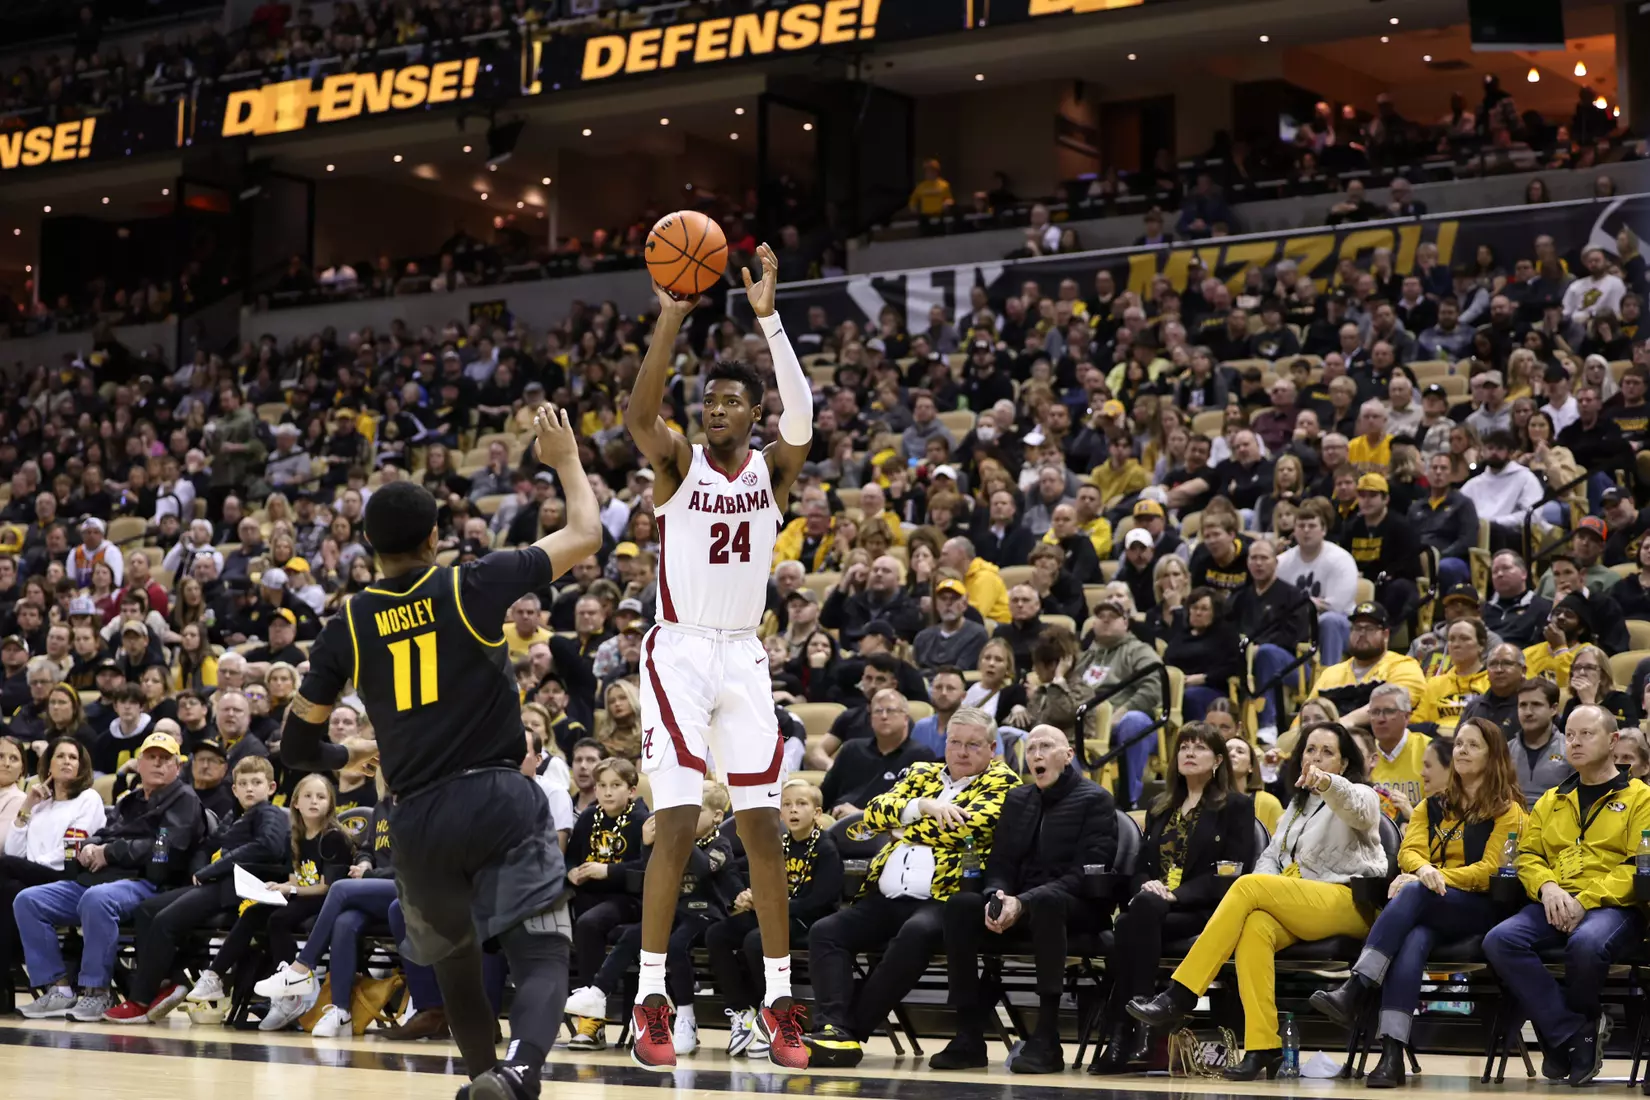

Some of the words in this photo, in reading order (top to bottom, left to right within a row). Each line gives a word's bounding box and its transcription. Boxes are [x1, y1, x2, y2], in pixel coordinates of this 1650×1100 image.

[580, 0, 882, 80] DEFENSE!
[222, 57, 481, 137] DENSE!
[688, 489, 770, 514] ALABAMA
[709, 521, 751, 564] 24
[374, 598, 435, 636] MOSLEY
[386, 631, 439, 711] 11
